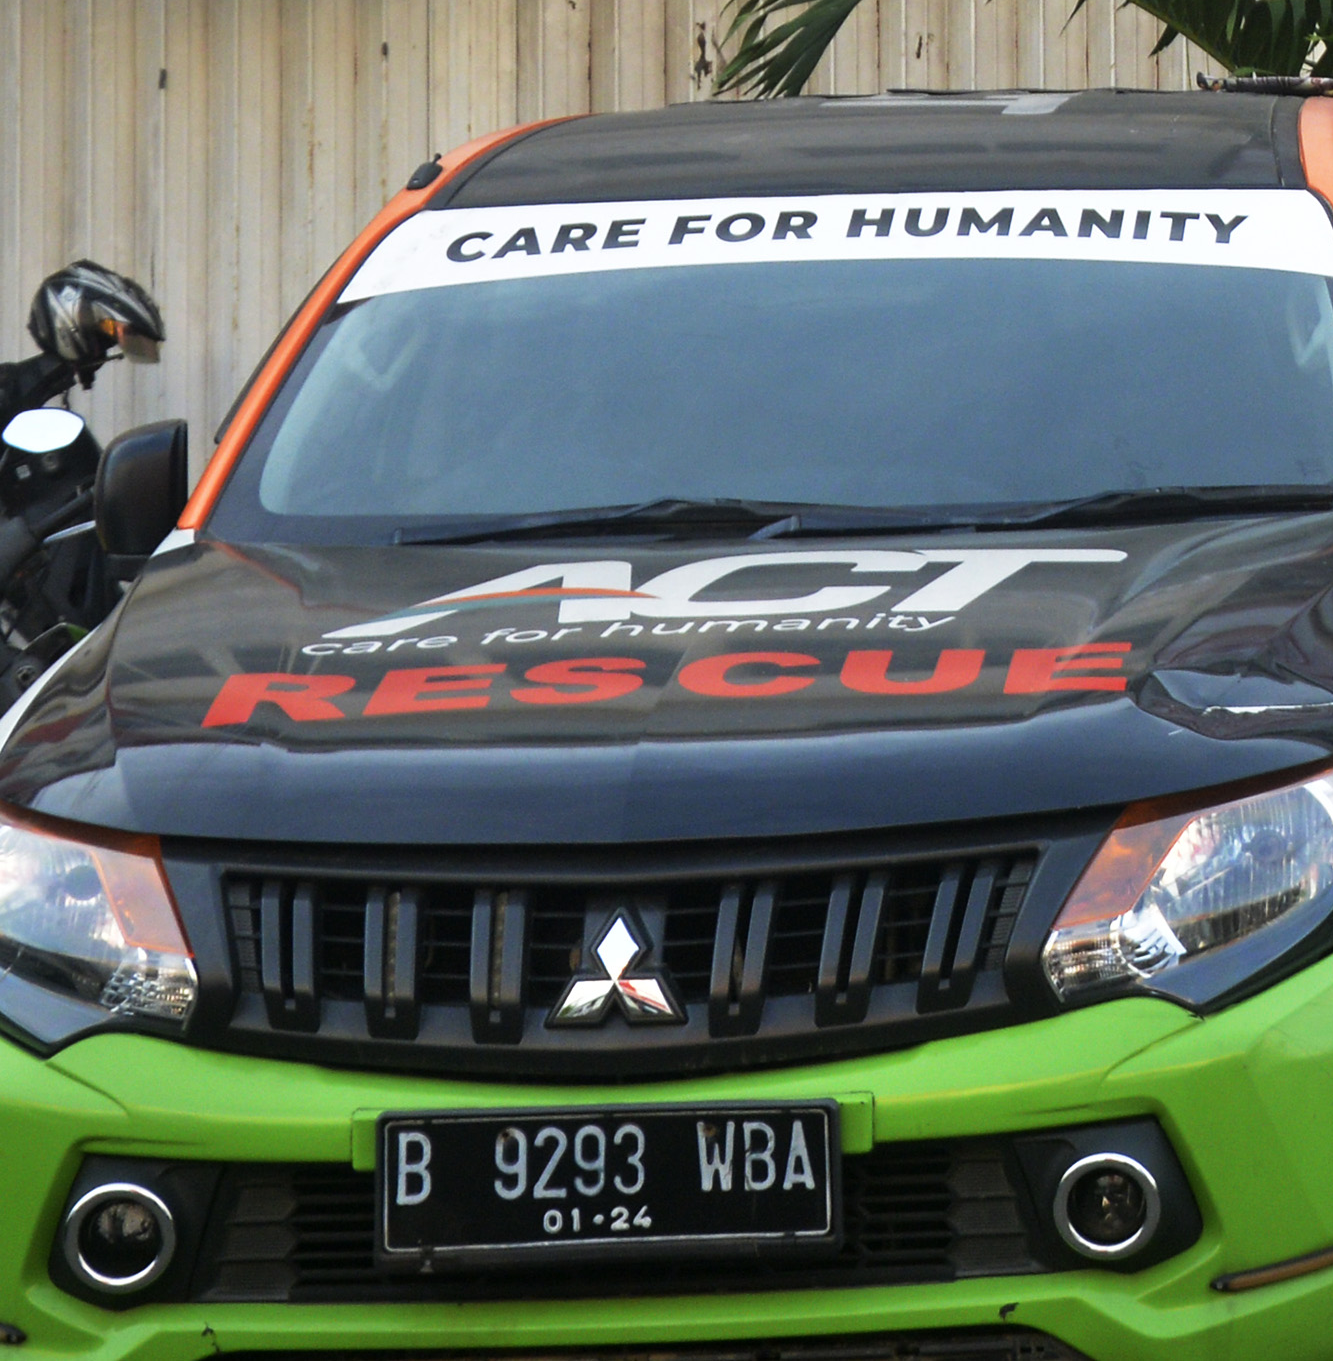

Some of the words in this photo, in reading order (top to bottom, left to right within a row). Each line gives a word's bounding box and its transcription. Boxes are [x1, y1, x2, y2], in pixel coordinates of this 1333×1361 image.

[445, 217, 645, 265] CARE
[667, 210, 817, 247] FOR
[846, 205, 1249, 246] HUMANITY
[300, 632, 459, 659] care
[476, 618, 583, 650] for
[606, 609, 956, 649] humanity
[320, 548, 1129, 639] ACT
[201, 641, 1133, 729] RESCUE
[396, 1132, 432, 1206] B
[494, 1123, 646, 1201] 9293
[696, 1120, 815, 1192] WBA
